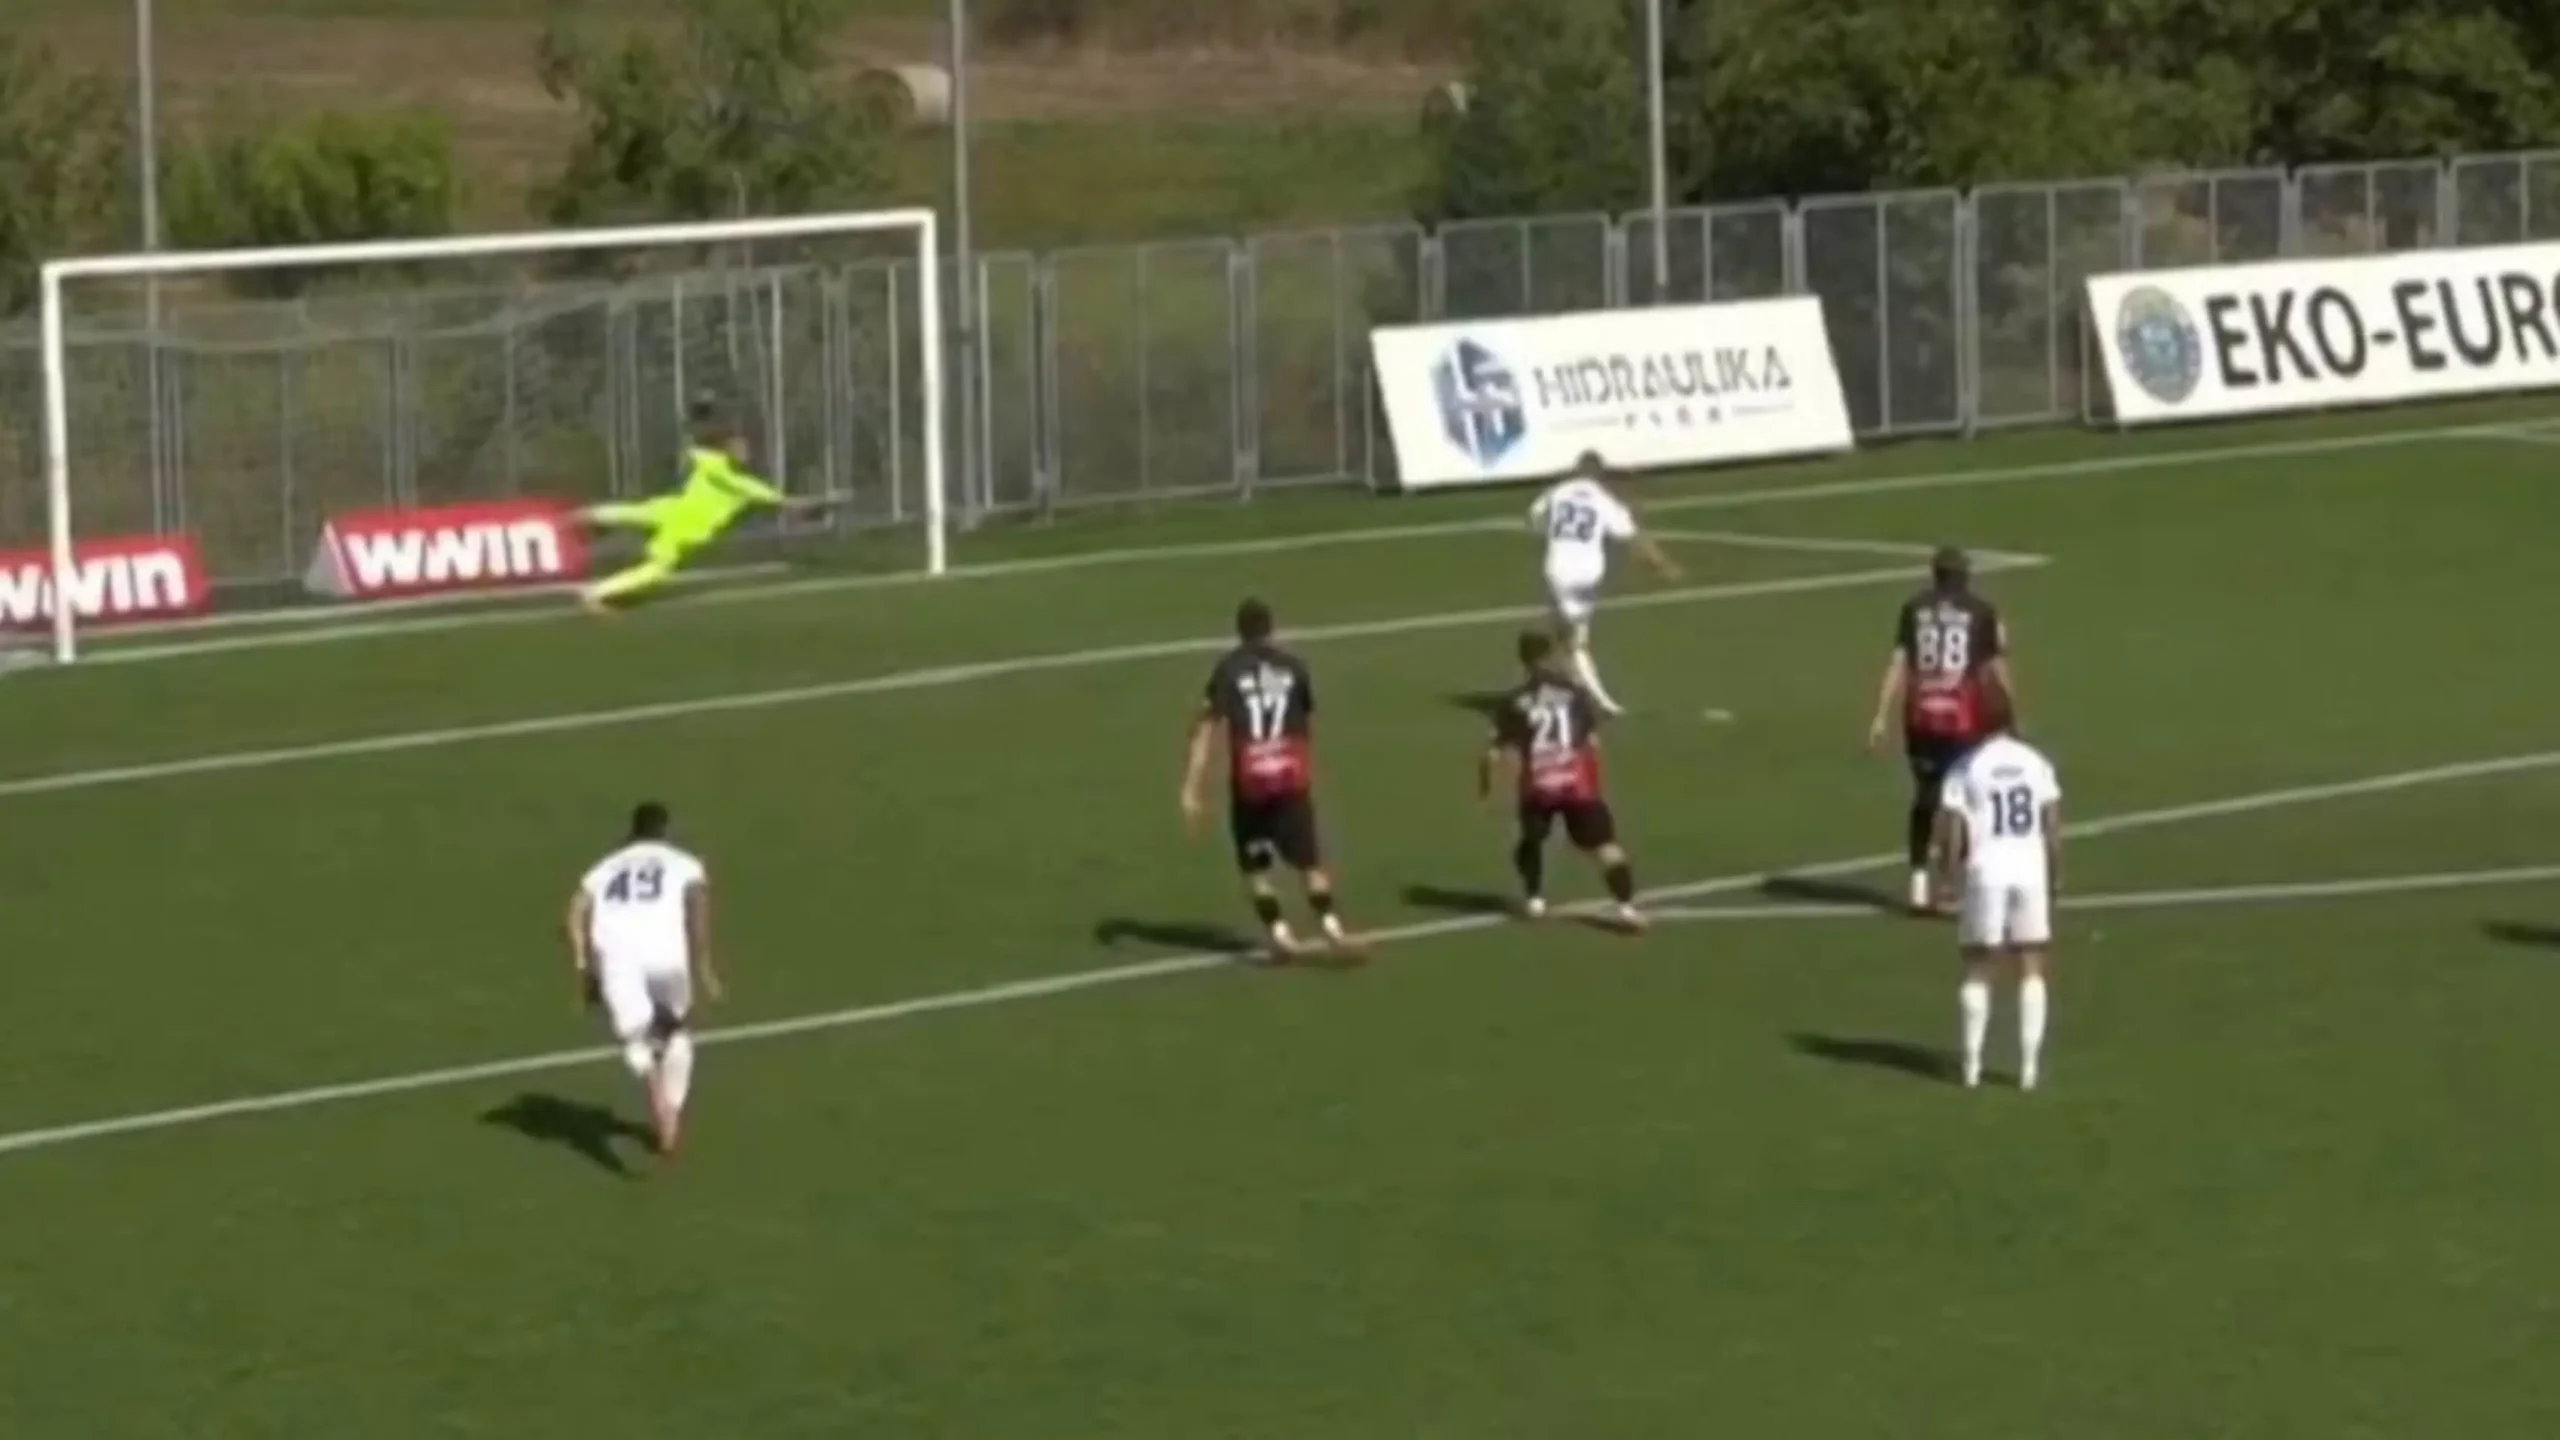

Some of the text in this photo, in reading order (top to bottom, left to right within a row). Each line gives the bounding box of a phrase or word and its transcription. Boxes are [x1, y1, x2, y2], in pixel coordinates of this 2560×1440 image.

[2205, 268, 2560, 388] EKO-EUR
[1532, 344, 1792, 409] HIDRAULIKA
[1554, 500, 1598, 543] 22
[1916, 625, 1969, 671] 88
[1245, 691, 1288, 741] 17
[1528, 705, 1572, 750] 21
[1990, 785, 2033, 837] 18
[604, 862, 664, 903] 49
